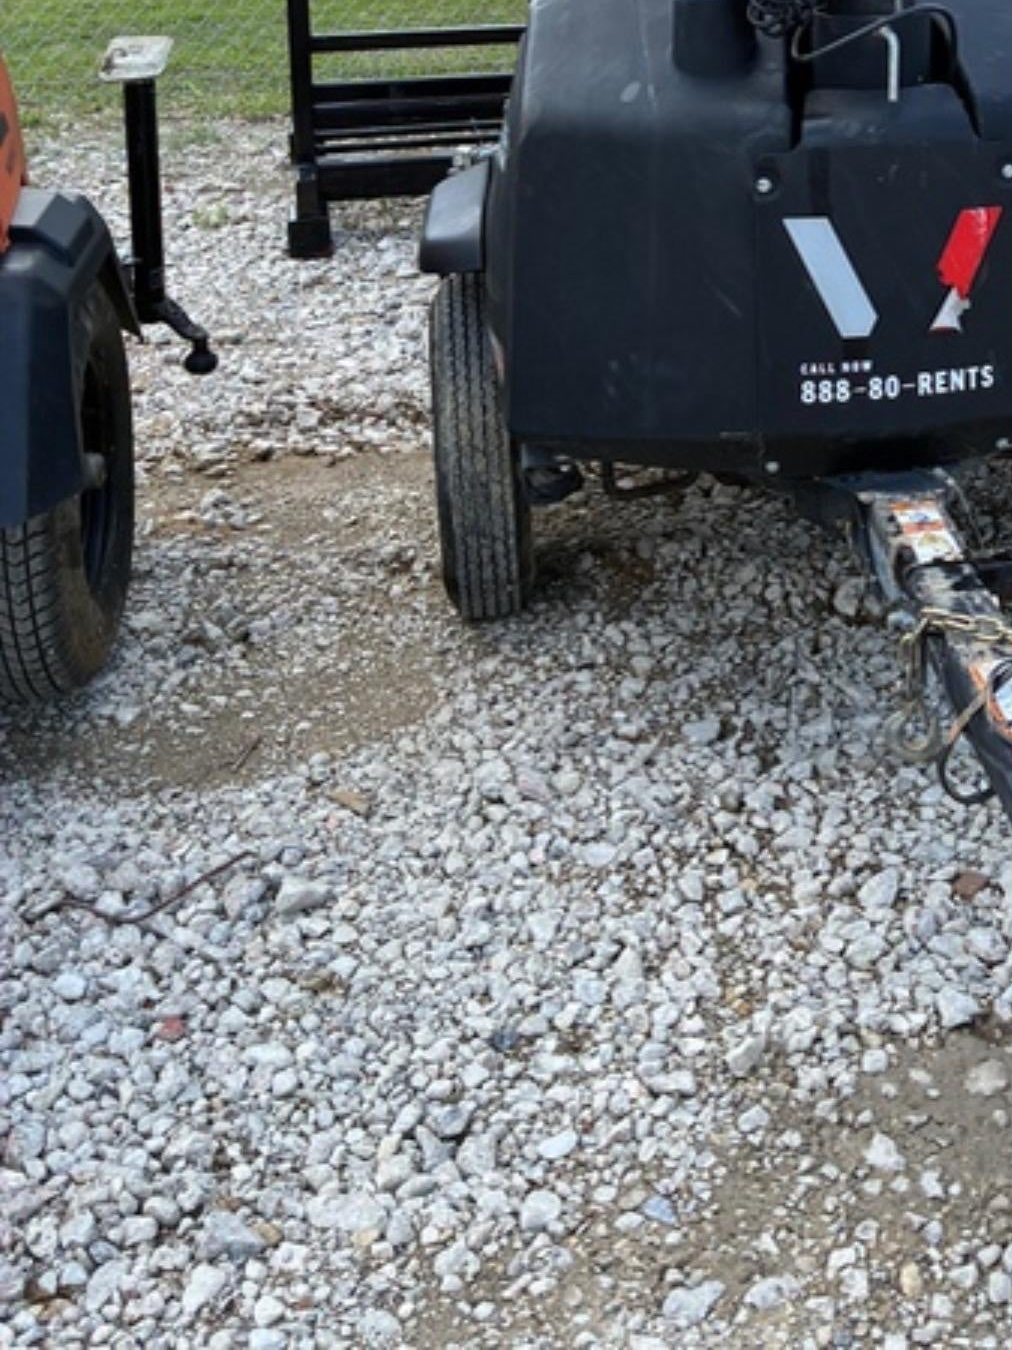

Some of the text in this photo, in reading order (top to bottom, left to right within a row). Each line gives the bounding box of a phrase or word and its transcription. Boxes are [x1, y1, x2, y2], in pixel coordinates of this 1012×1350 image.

[799, 360, 873, 376] CALL NOW
[799, 364, 995, 404] 888-80-RENTS
